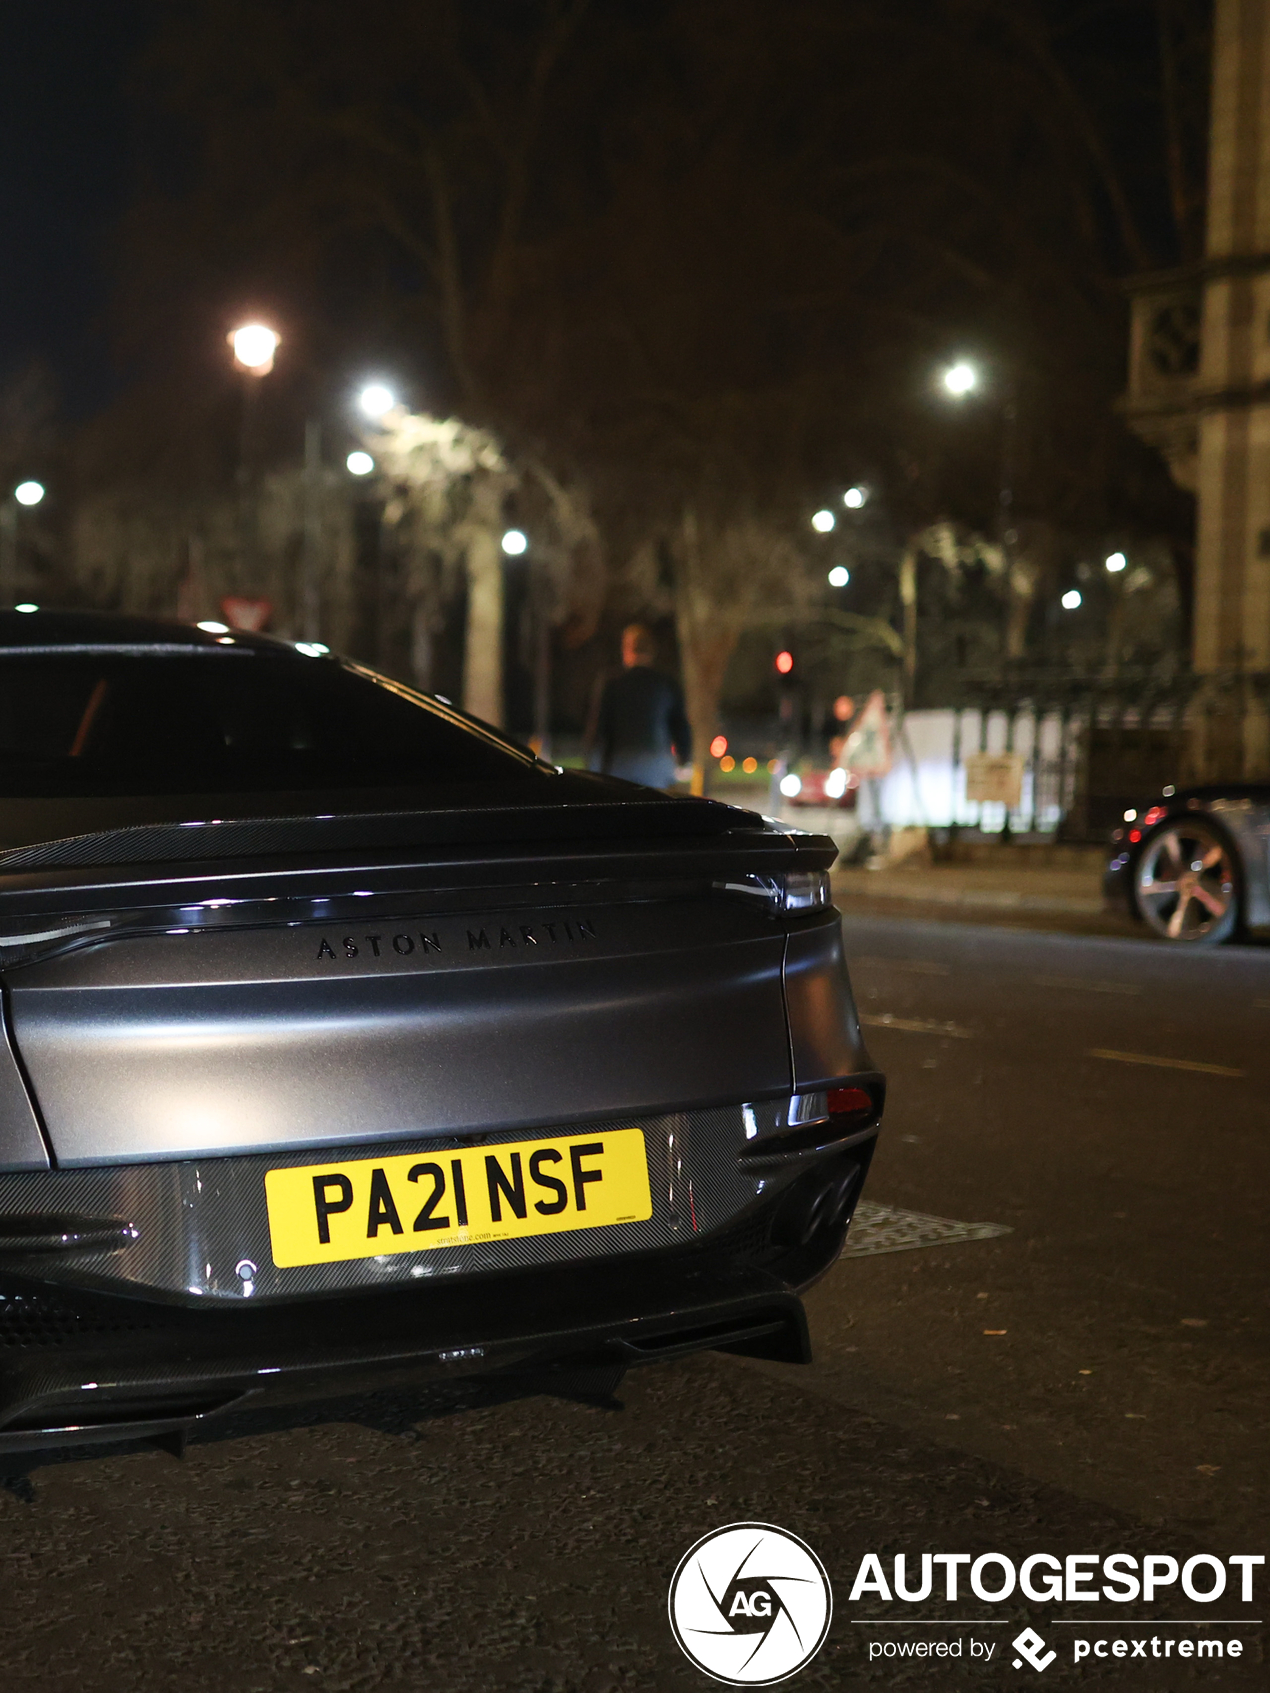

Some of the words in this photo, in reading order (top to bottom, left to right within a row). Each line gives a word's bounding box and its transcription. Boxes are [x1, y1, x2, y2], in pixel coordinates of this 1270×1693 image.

[317, 932, 442, 960] ASTON
[466, 919, 598, 951] MARTIN
[313, 1160, 468, 1243] PA21
[485, 1143, 603, 1221] NSF
[436, 1232, 492, 1245] stratstone.com
